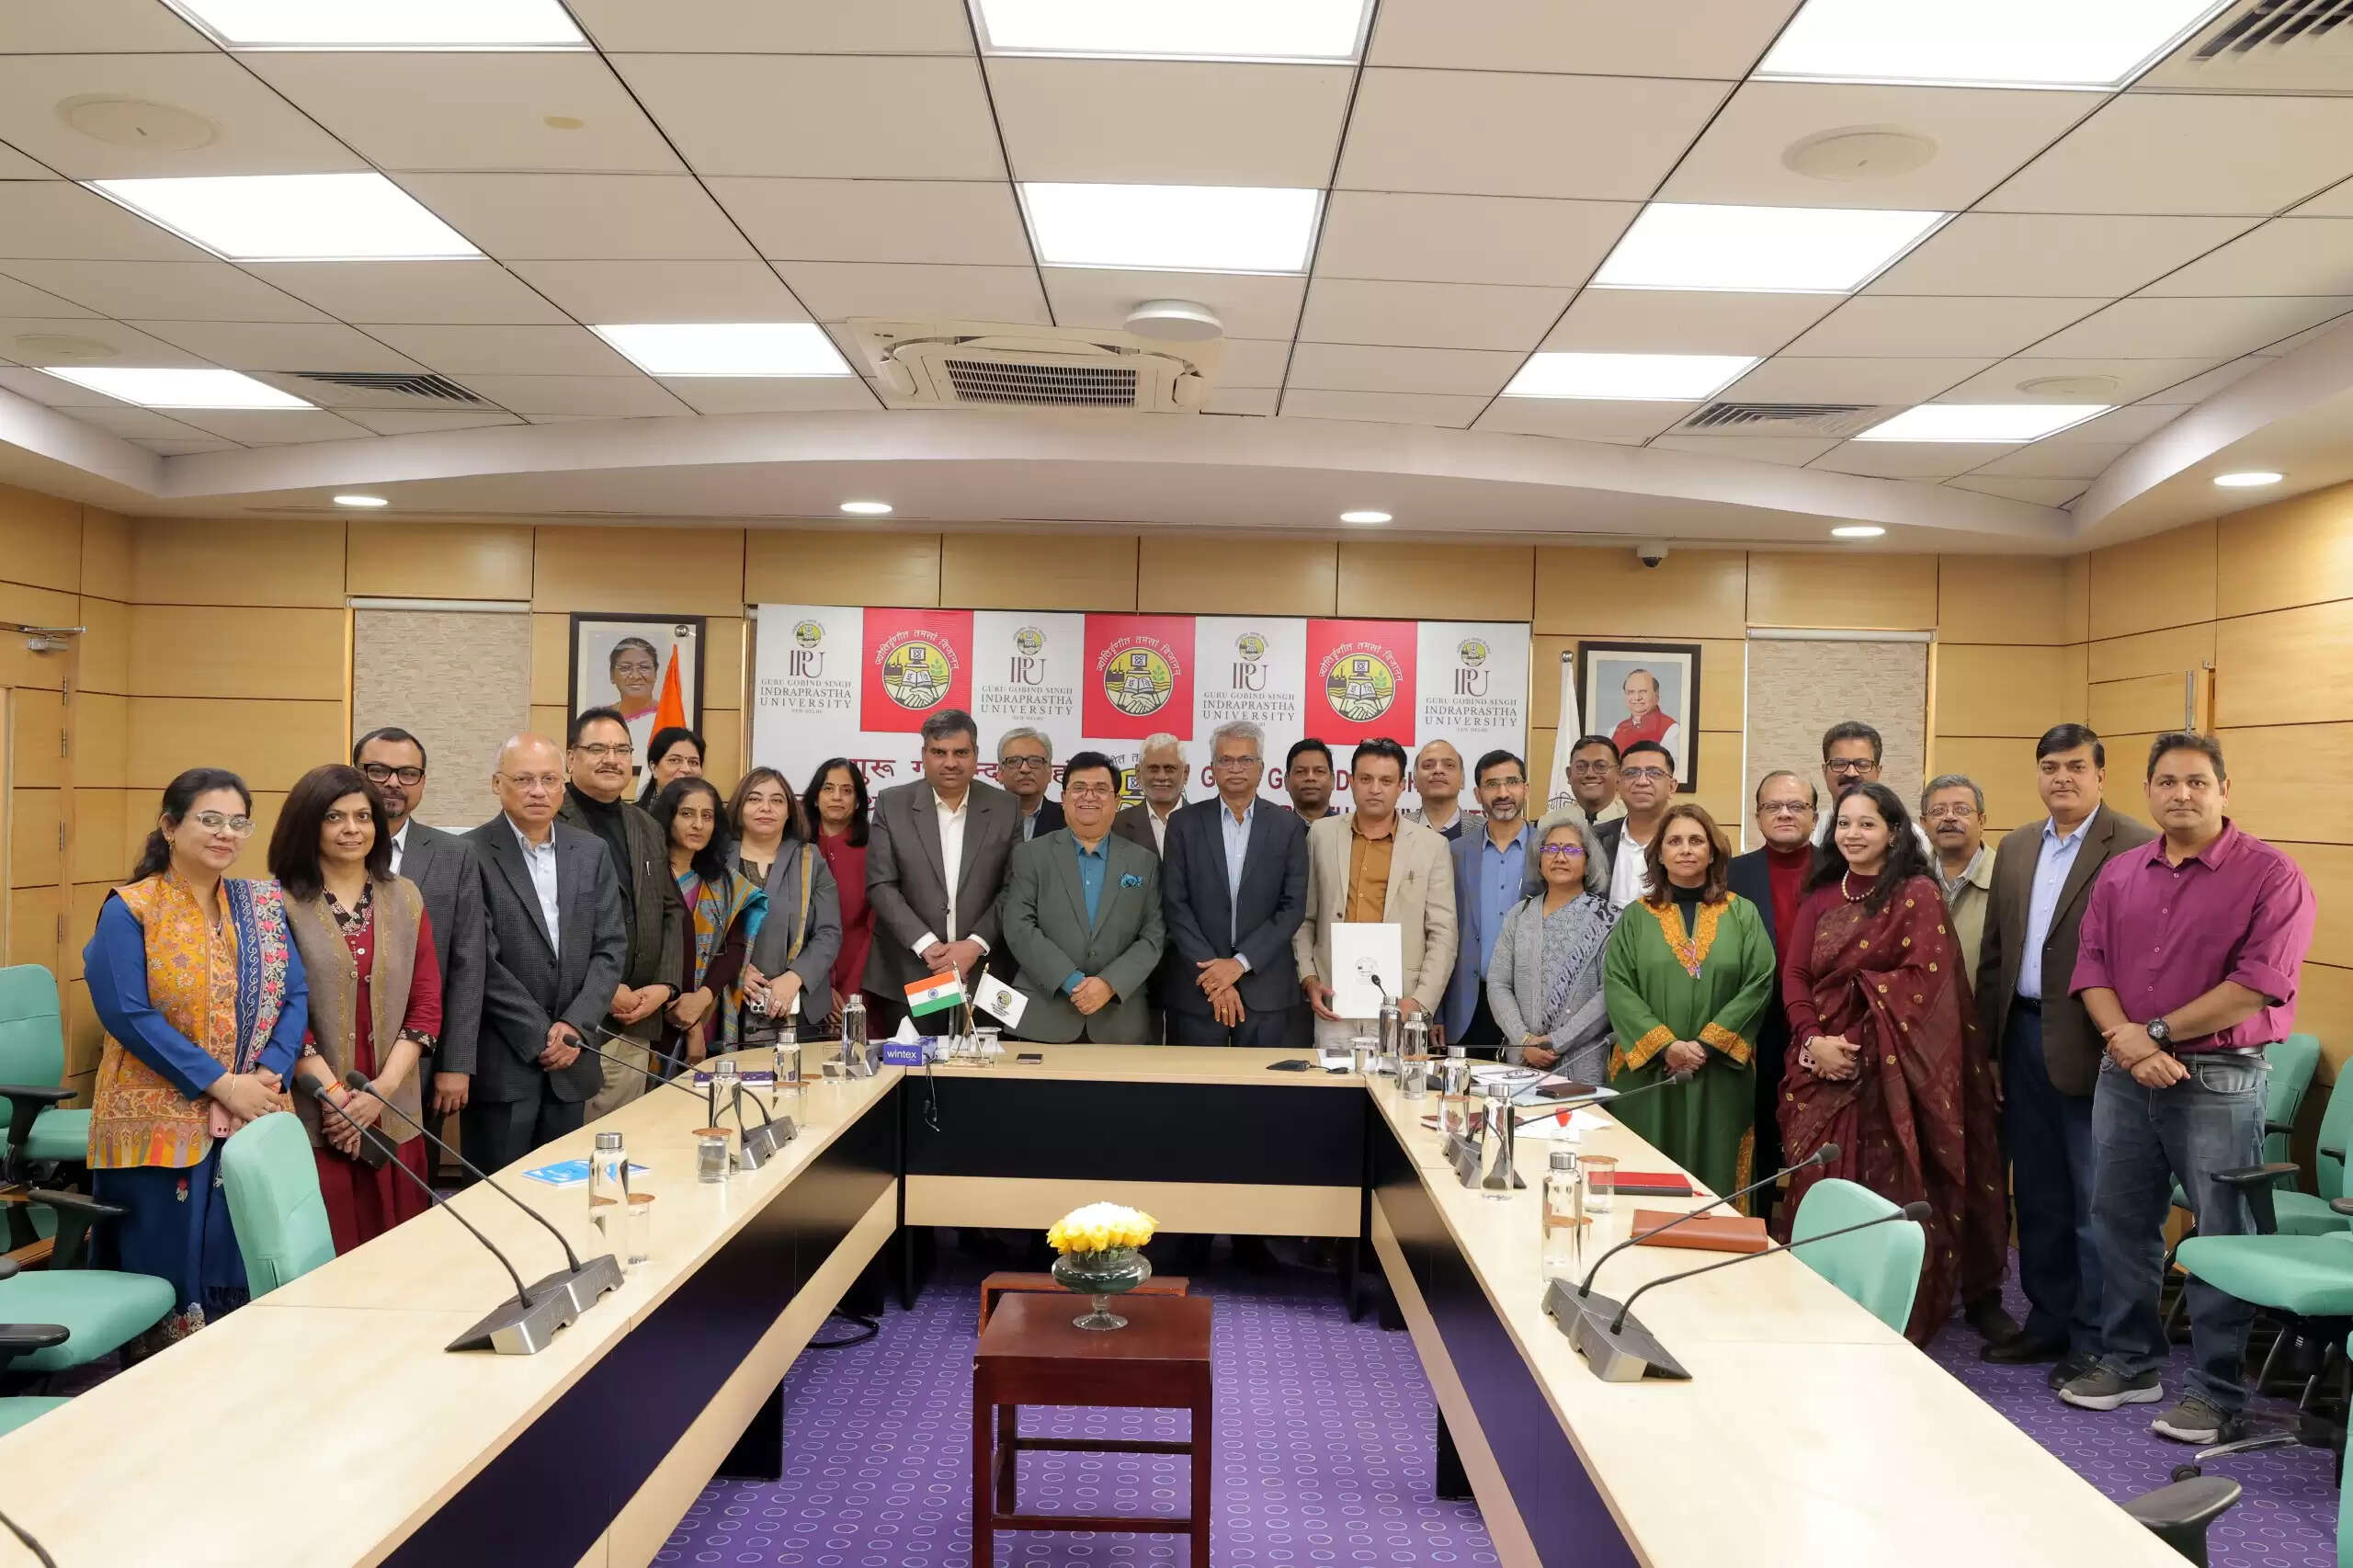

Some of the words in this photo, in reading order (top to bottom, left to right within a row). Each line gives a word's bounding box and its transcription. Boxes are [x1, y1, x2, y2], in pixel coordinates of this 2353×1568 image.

[760, 687, 851, 699] INDRAPRASTHA
[760, 698, 851, 709] UNIVERSITY
[981, 694, 1073, 705] INDRAPRASTHA
[1203, 700, 1295, 710] INDRAPRASTHA
[981, 704, 1073, 715] UNIVERSITY
[1426, 705, 1518, 716] INDRAPRASTHA
[1203, 710, 1295, 721] UNIVERSITY
[1426, 716, 1518, 726] UNIVERSITY
[887, 1048, 916, 1059] wintex
